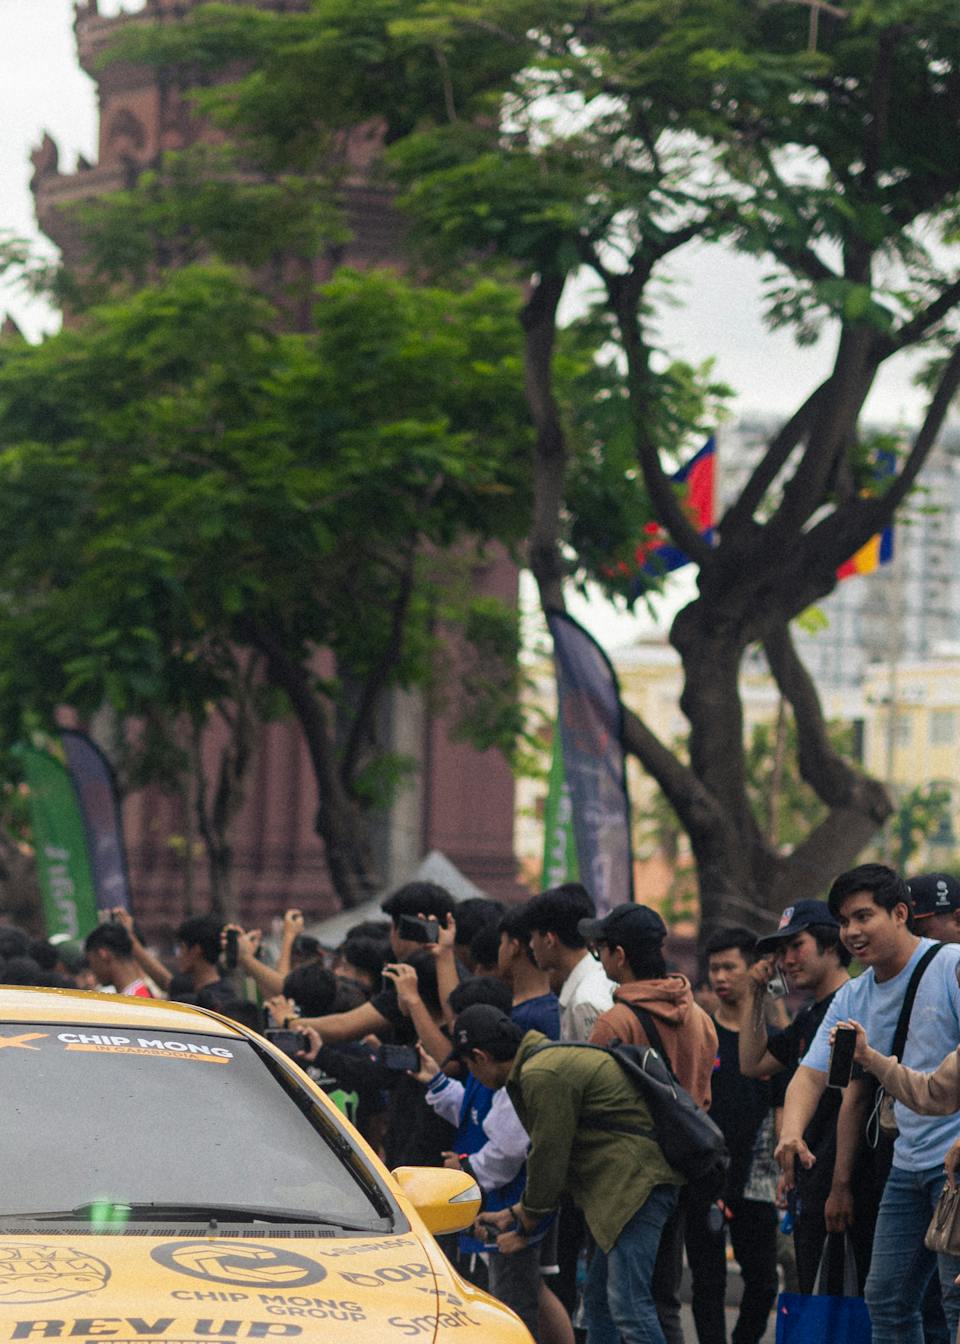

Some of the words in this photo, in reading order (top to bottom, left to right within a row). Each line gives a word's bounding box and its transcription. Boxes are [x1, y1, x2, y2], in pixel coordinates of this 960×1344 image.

[57, 1033, 130, 1047] CHIP
[137, 1037, 234, 1058] MONG
[170, 1290, 249, 1303] CHIP
[257, 1294, 363, 1312] MONG
[265, 1305, 368, 1323] GROUP
[388, 1306, 481, 1336] Smart
[9, 1317, 175, 1340] REV
